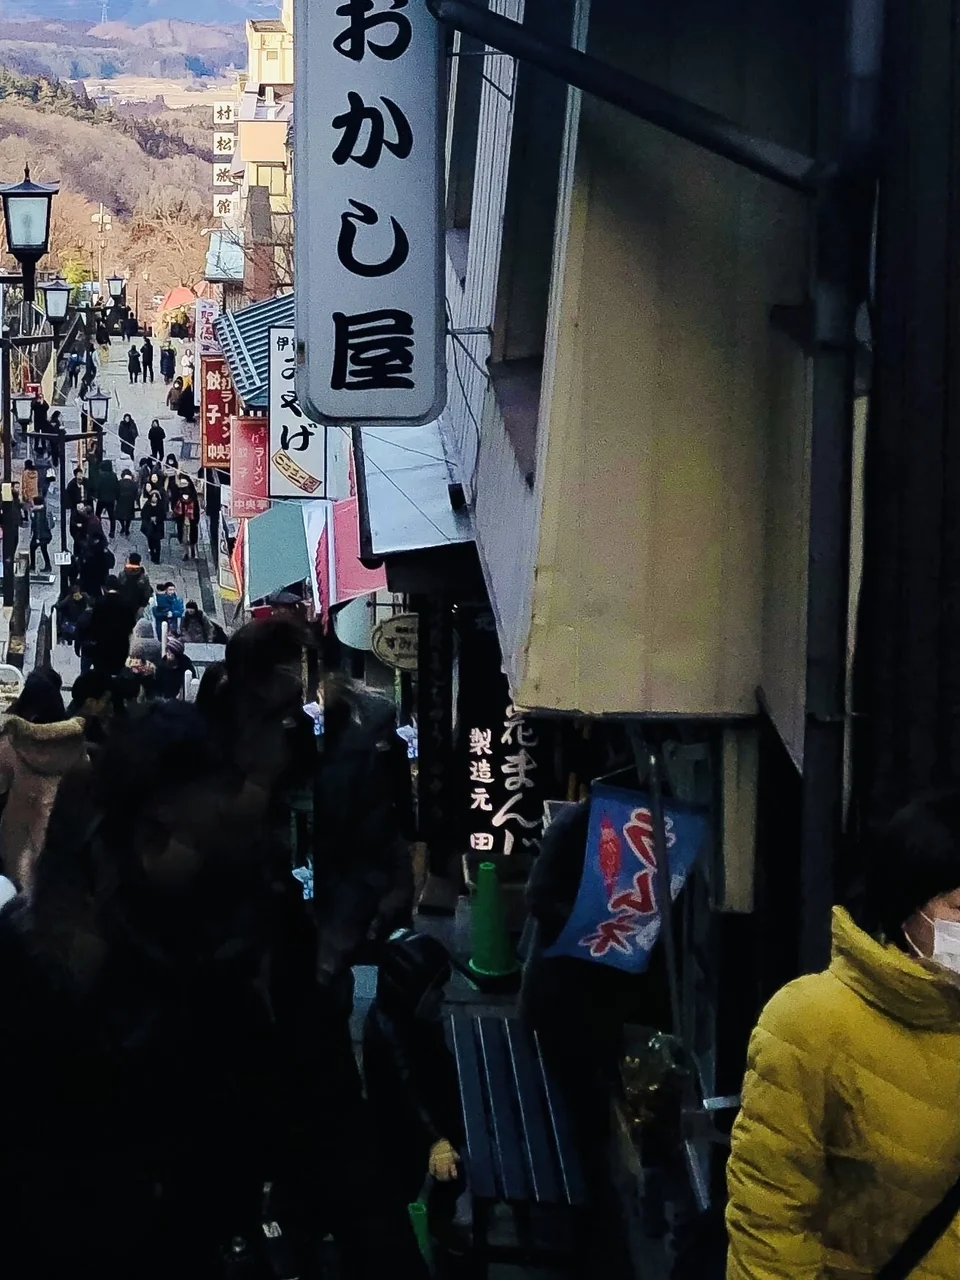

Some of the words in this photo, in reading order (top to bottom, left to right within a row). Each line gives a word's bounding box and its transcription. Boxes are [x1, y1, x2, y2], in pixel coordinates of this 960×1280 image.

[215, 105, 232, 214] 村松旅館
[206, 370, 222, 425] 餃子
[468, 726, 496, 812] 製造元
